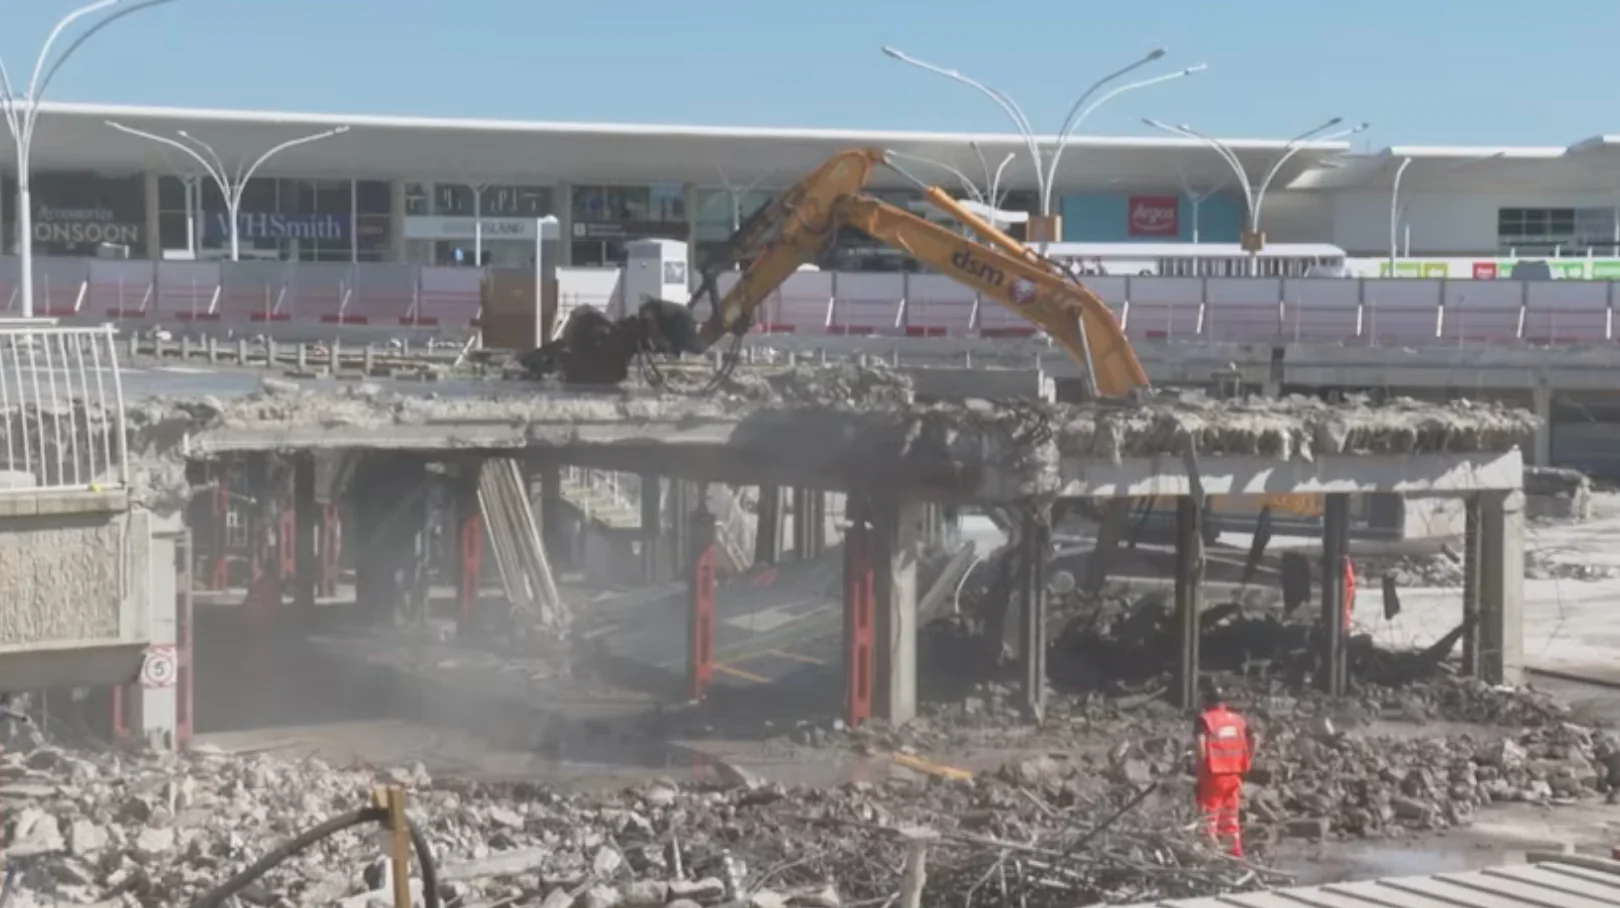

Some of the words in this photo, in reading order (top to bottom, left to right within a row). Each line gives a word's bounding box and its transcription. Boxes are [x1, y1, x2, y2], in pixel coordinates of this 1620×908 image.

[1132, 203, 1175, 224] Argos
[31, 222, 138, 242] ONSOON
[216, 212, 341, 239] WHSmith
[952, 251, 1005, 287] dsm
[155, 661, 165, 676] 5
